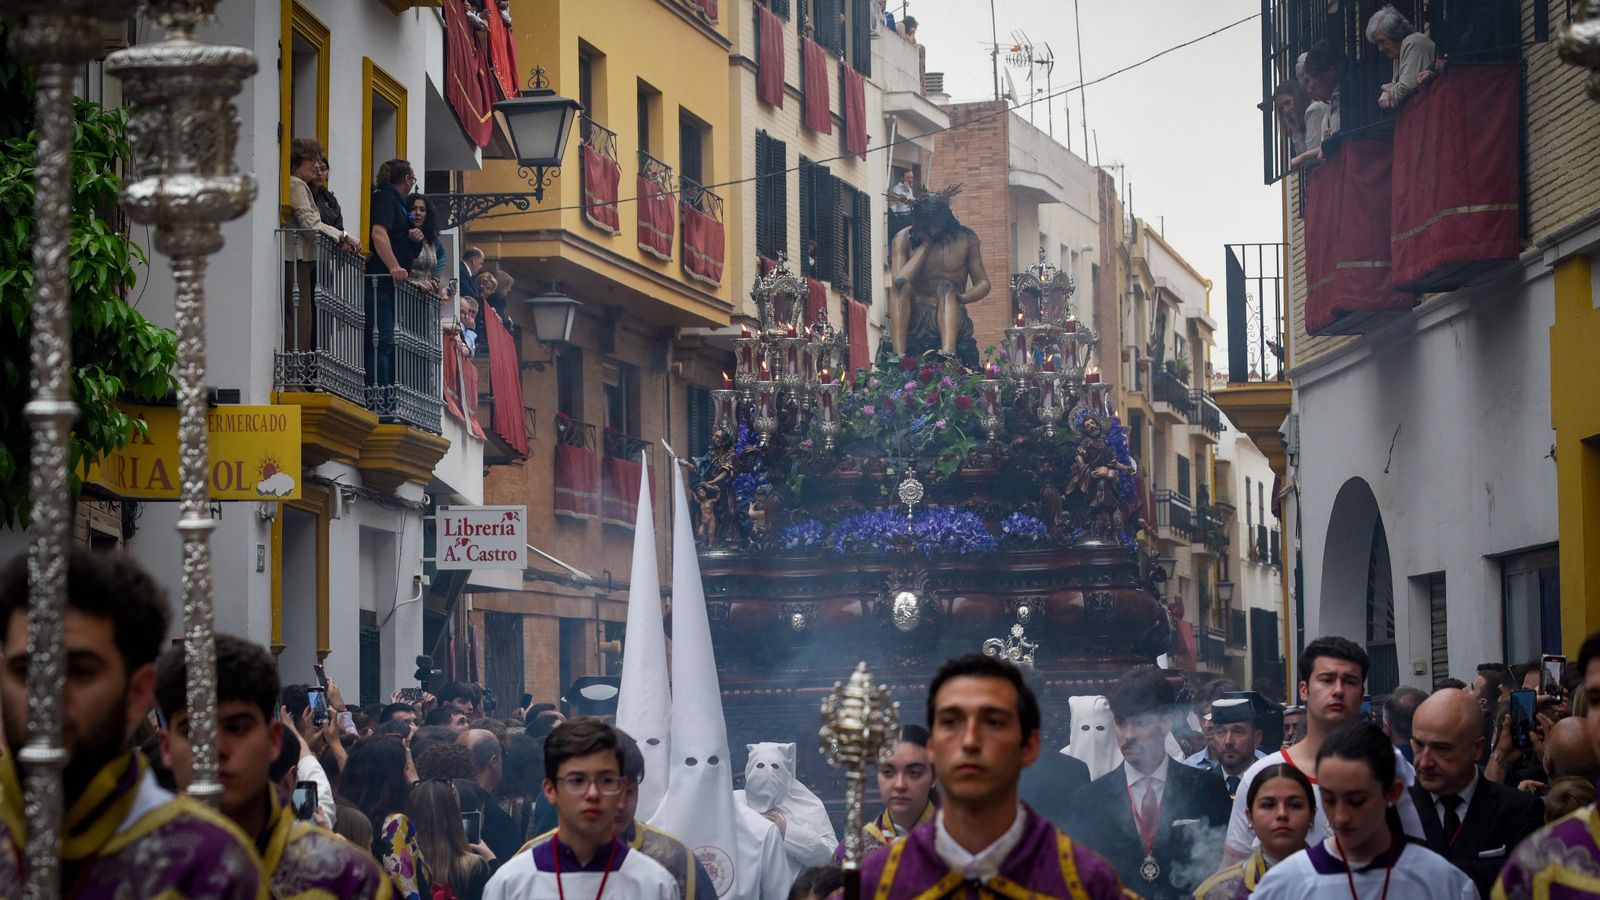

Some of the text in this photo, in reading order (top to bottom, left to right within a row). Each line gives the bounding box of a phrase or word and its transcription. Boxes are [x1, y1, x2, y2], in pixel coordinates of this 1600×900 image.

[208, 413, 287, 433] ERMERCADO
[212, 459, 252, 492] OL
[444, 516, 516, 537] Librería
[443, 544, 517, 562] A. Castro
